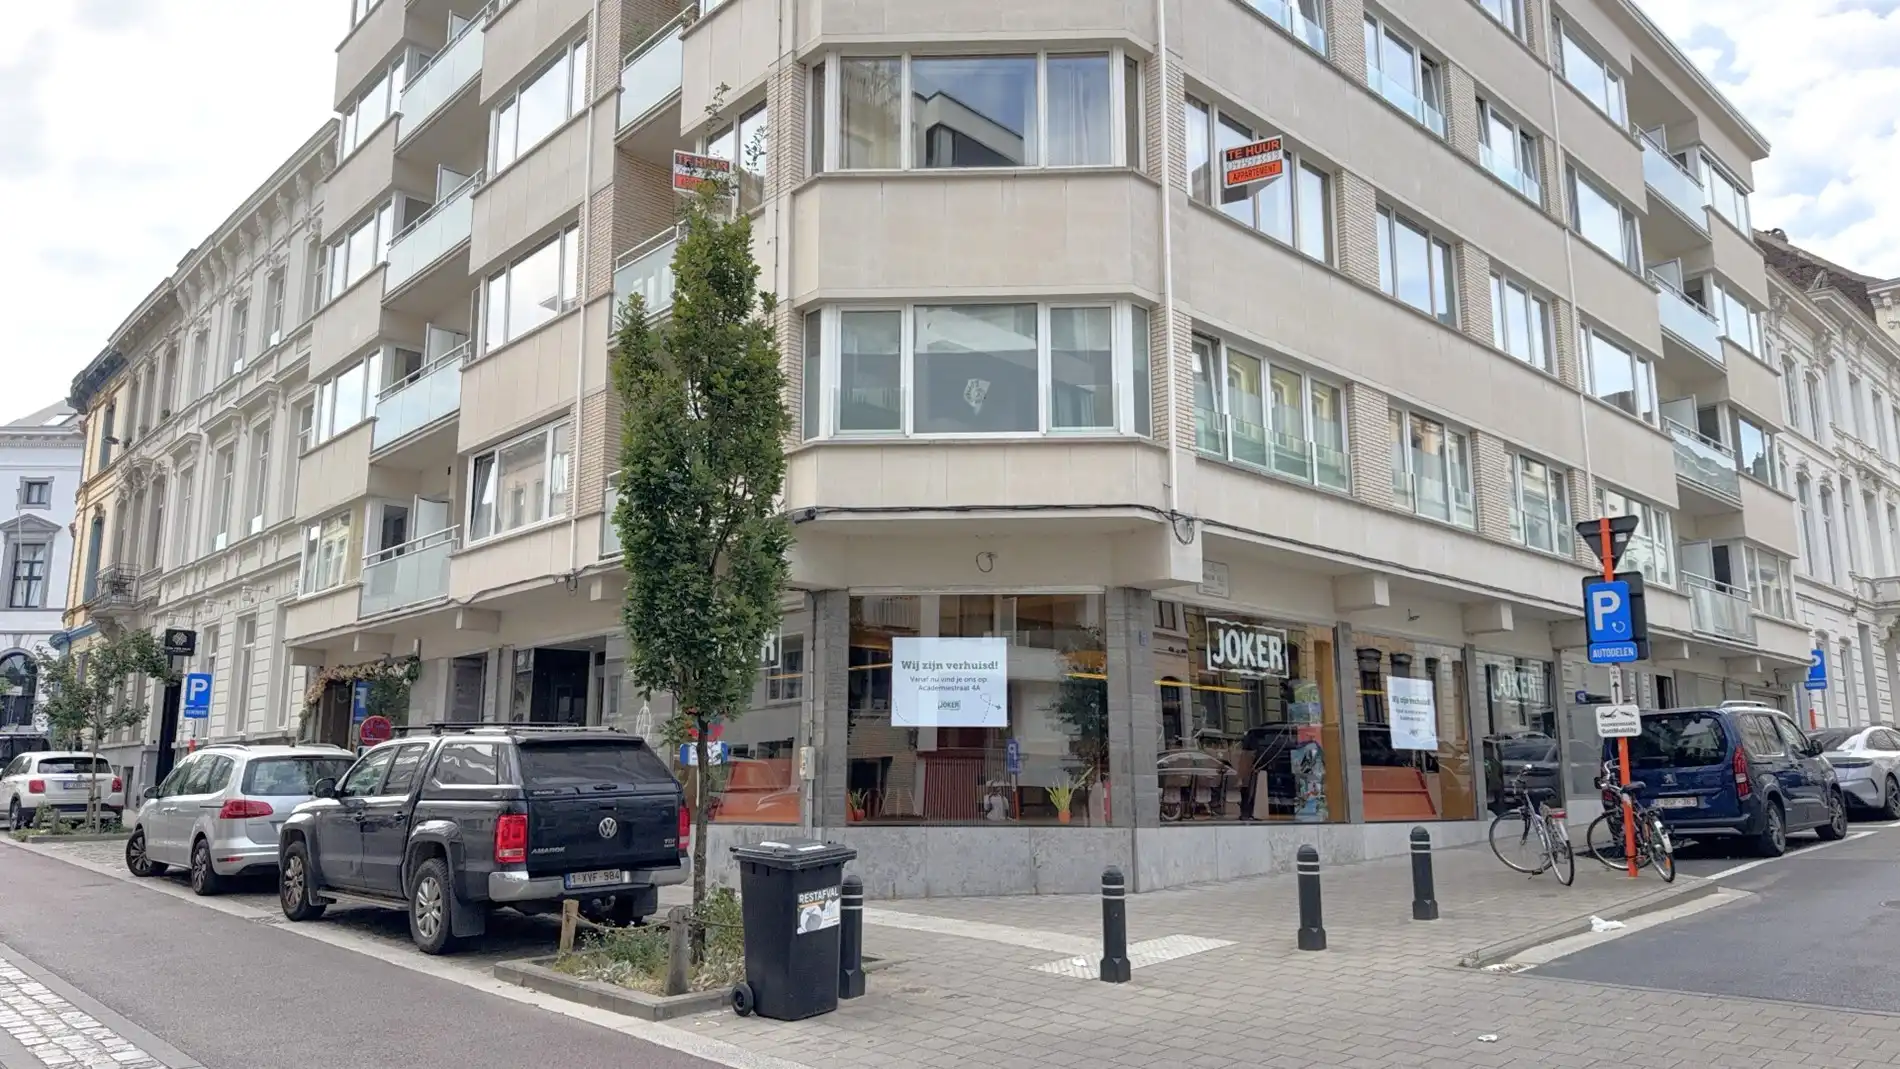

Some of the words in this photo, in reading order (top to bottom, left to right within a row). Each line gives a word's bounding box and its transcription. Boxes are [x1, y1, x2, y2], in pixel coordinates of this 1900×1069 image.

[1228, 149, 1242, 160] TE
[1246, 140, 1279, 157] HUUR
[1233, 164, 1276, 181] APPARTEMENT
[1592, 590, 1621, 631] P
[1212, 628, 1285, 670] JOKER
[1592, 647, 1634, 658] AUTODELEN
[901, 660, 919, 671] Wij
[922, 660, 944, 672] zijn
[946, 660, 998, 670] verhuisd!
[956, 676, 963, 684] je
[1495, 669, 1538, 701] JOKER
[189, 678, 208, 701] P
[939, 701, 960, 709] JOKER
[531, 846, 565, 854] AMAROK
[799, 887, 839, 904] RESTAFVAL
